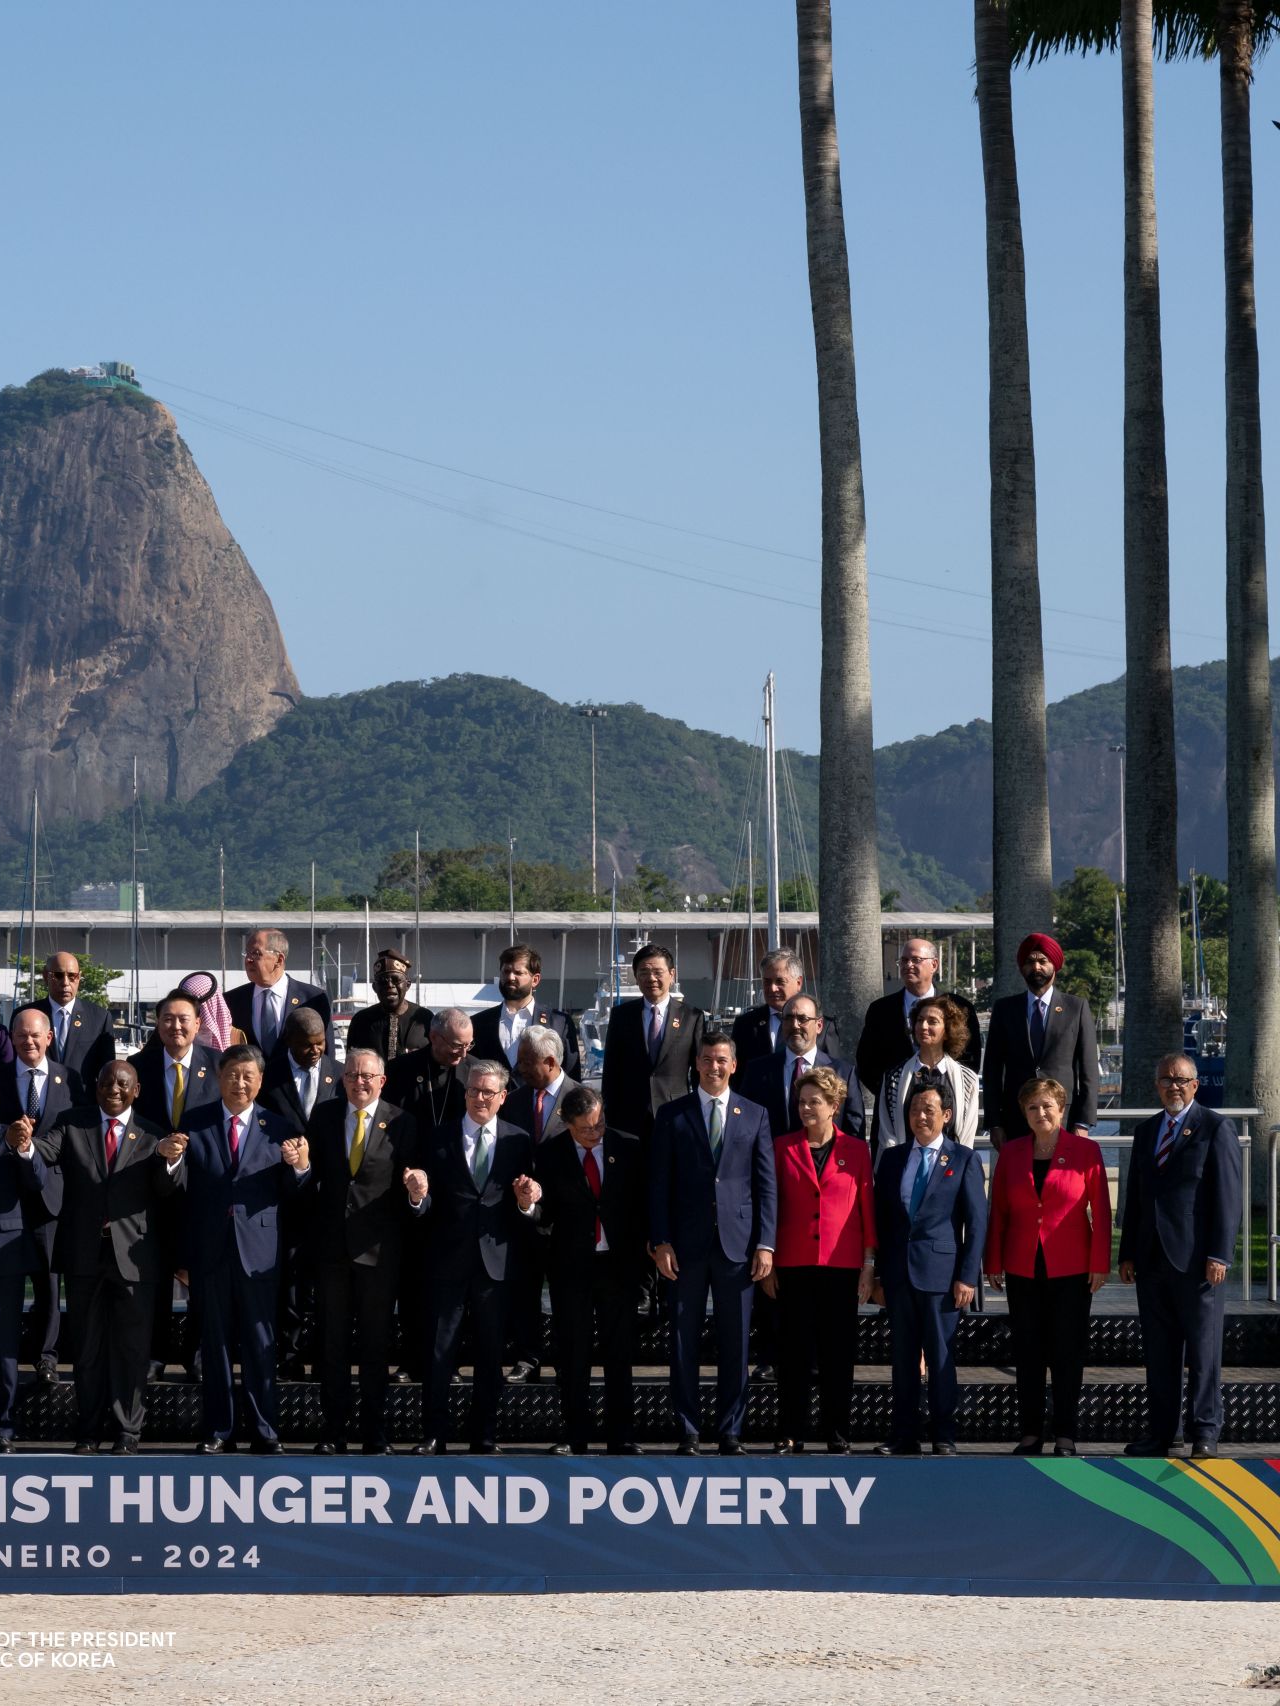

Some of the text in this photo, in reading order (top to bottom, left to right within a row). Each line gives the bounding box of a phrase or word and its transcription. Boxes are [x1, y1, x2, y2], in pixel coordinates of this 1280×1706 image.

[109, 1475, 393, 1524] HUNGER
[407, 1475, 550, 1524] AND
[569, 1476, 876, 1525] POVERTY
[163, 1544, 261, 1568] 2024
